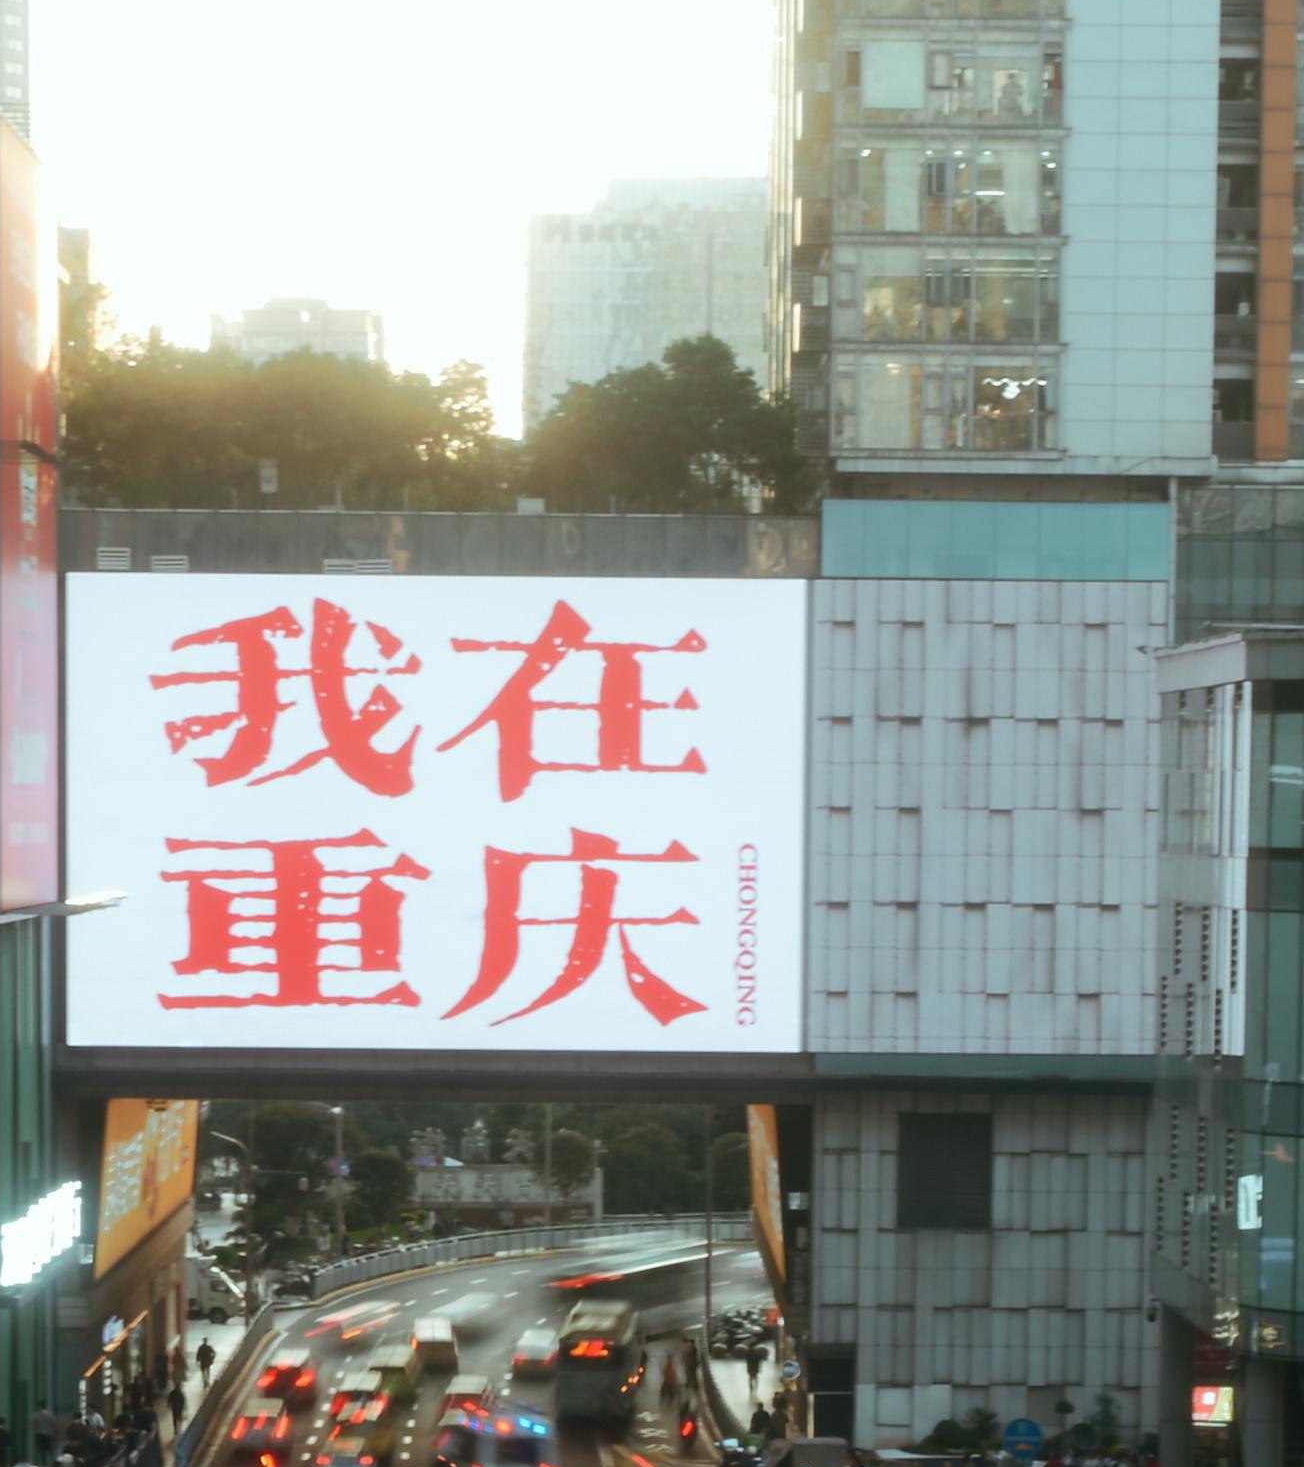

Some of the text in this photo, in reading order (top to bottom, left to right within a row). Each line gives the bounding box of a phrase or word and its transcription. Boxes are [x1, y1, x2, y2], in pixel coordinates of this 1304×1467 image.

[149, 597, 708, 803] 我在
[157, 827, 709, 1027] 重庆
[735, 843, 758, 1027] CHONGQING
